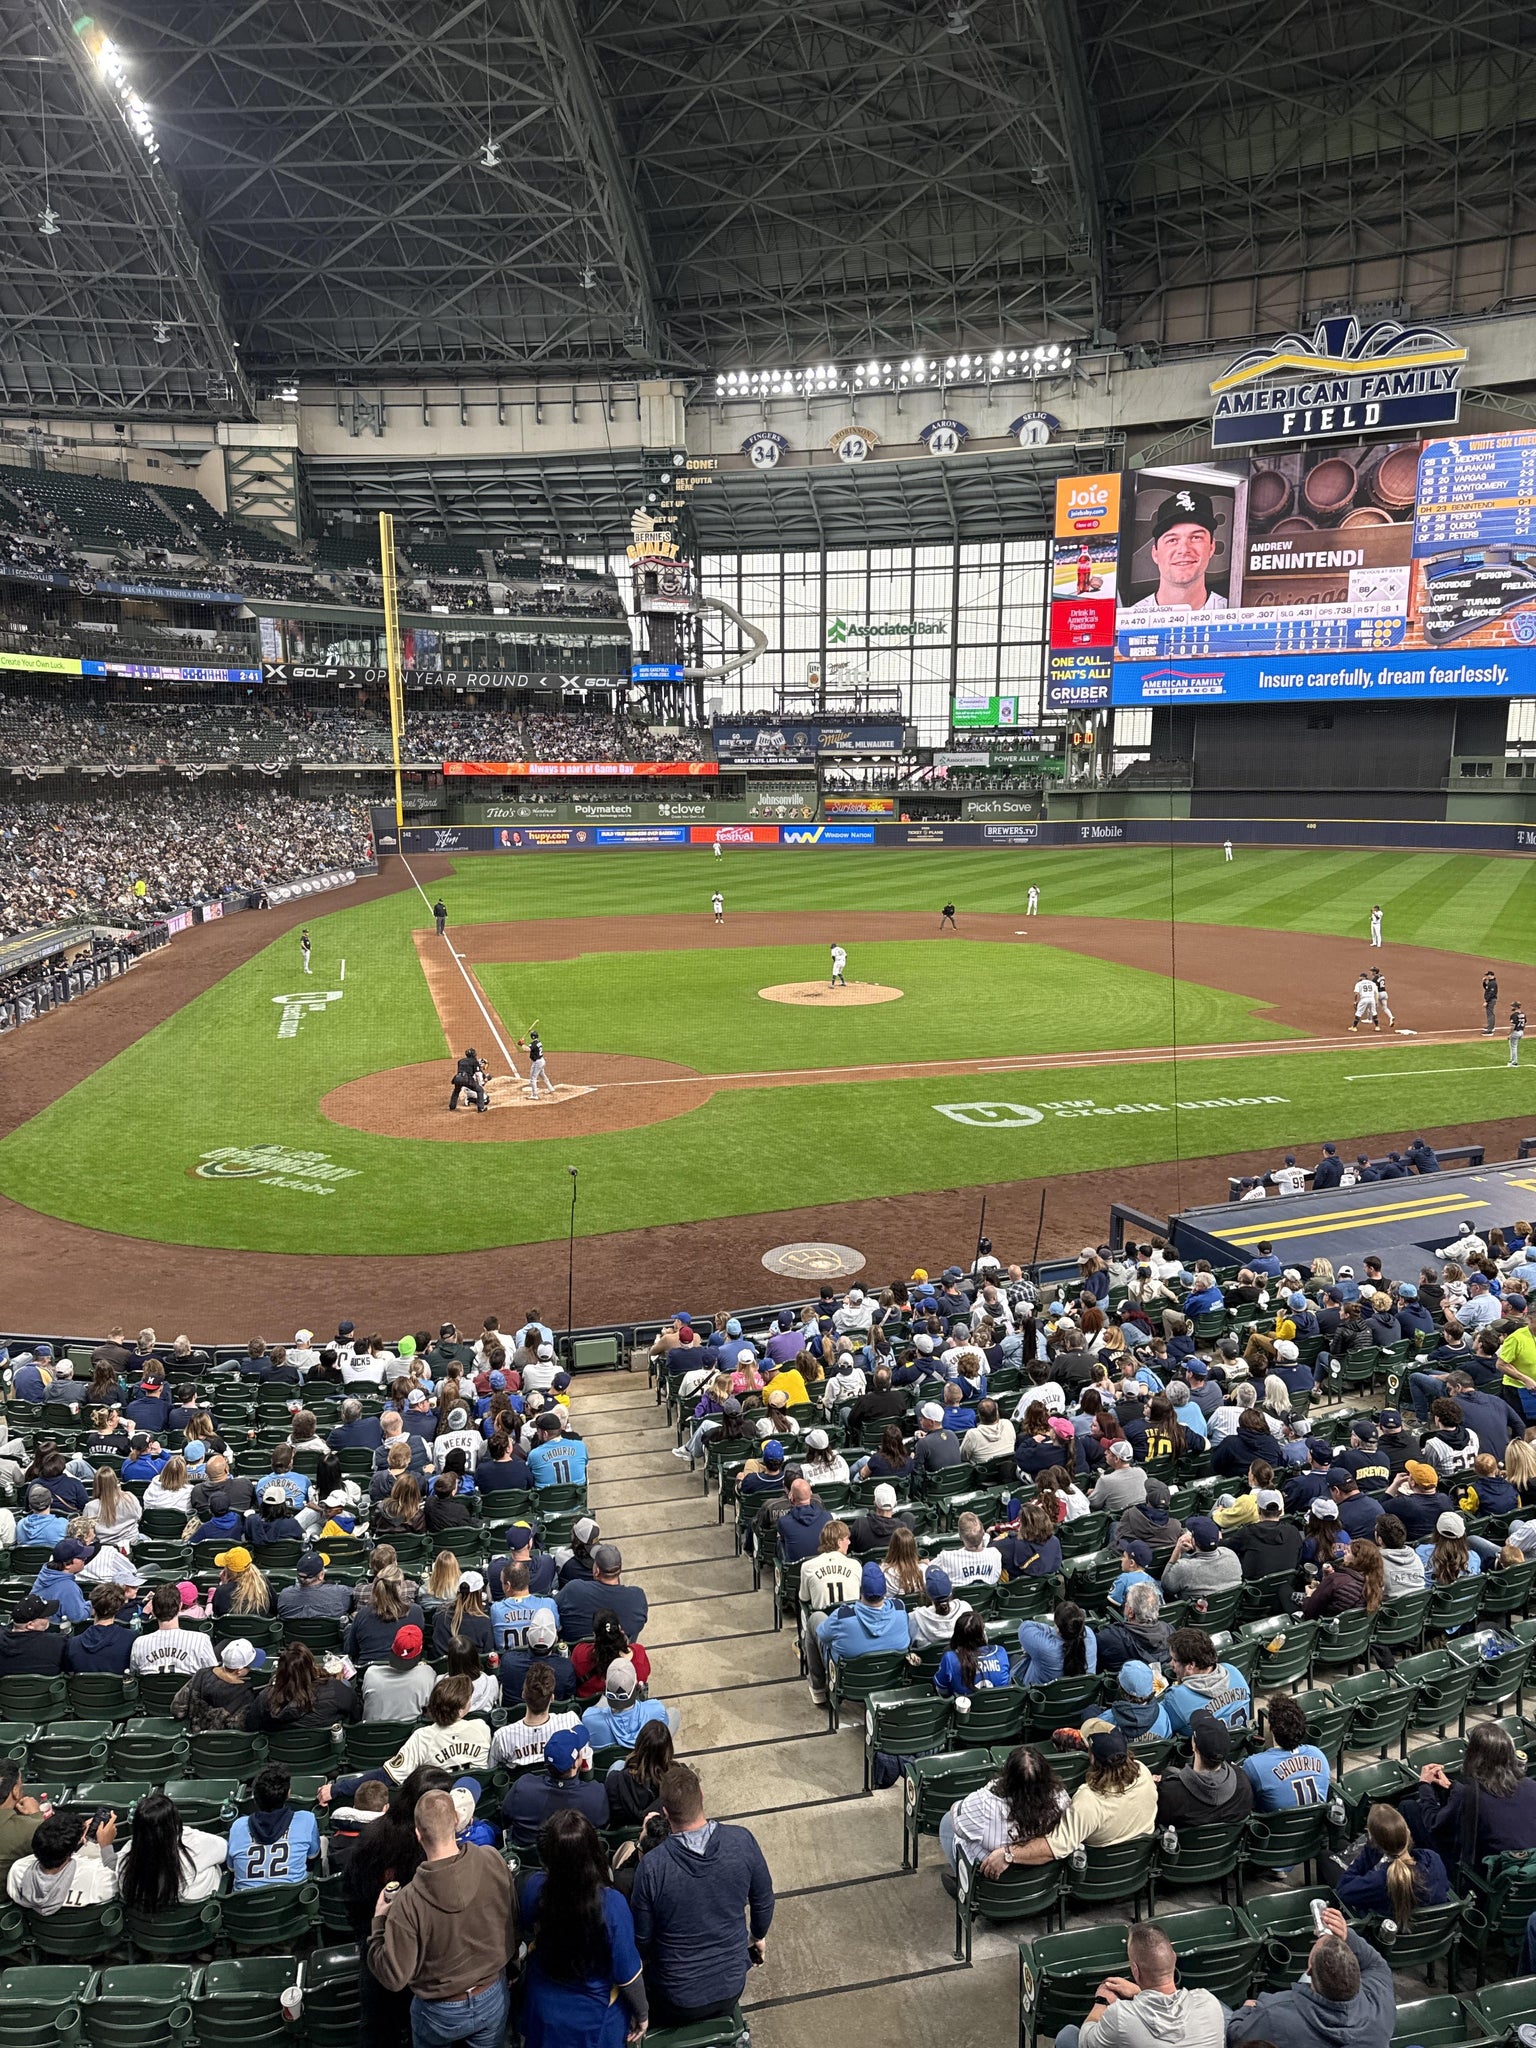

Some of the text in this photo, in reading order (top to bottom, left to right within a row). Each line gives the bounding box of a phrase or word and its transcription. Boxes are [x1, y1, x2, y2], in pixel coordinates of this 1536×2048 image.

[1216, 367, 1460, 416] AMERICAN FAMILY
[1023, 413, 1047, 421] SELIG
[1283, 404, 1380, 434] FIELD
[932, 421, 957, 430] AARON
[749, 432, 781, 443] FINGERS
[834, 426, 870, 441] ROBINSON
[1030, 427, 1039, 445] 1
[933, 434, 954, 451] 44
[1470, 438, 1512, 451] WHITE SOX
[754, 445, 775, 463] 34
[842, 441, 863, 458] 42
[686, 460, 718, 469] GONE!
[1455, 463, 1495, 473] MURAKAMI
[1454, 473, 1486, 482] VARGAS
[1453, 481, 1508, 492] MONTGOMERY
[1068, 484, 1108, 506] Joie
[1452, 493, 1474, 501] HAYS
[1452, 502, 1495, 511] BENINTENDI
[1450, 521, 1476, 530] QUERO
[635, 531, 671, 542] BERNIE'S
[1449, 531, 1479, 539] PETERS
[626, 542, 679, 559] CHALET
[1251, 541, 1293, 552] ANDREW
[1250, 549, 1364, 570] BENINTENDI
[1476, 571, 1511, 580] PERKINS
[1425, 581, 1472, 589] LOCKRIDGE
[166, 590, 191, 598] TEQUILA
[1434, 593, 1459, 601] ORTIZ
[1418, 605, 1453, 613] RENGIFO
[1462, 608, 1502, 617] SÁNCHEZ
[1067, 616, 1098, 624] America's
[1426, 621, 1455, 629] QUERO
[1130, 647, 1156, 656] BREWERS
[1, 657, 65, 669] Create Your Own Luck.
[1052, 656, 1110, 667] ONE CALL...
[240, 672, 259, 681] 2:41
[292, 668, 338, 678] GOLF
[365, 670, 408, 683] OPN
[416, 672, 456, 685] YEAR
[467, 673, 529, 687] ROUND
[584, 678, 628, 687] GOLF
[1051, 669, 1110, 680] THAT'S ALL!
[1258, 663, 1510, 690] Insure carefully, dream fearlessly.
[1143, 678, 1223, 689] AMERICAN FAMILY
[1051, 686, 1108, 700] GRUBER
[818, 732, 852, 747] Miller
[529, 764, 558, 774] Always
[758, 794, 803, 805] Johnsonville
[486, 807, 515, 818] Tito's
[575, 805, 632, 815] Polymatech
[671, 804, 705, 814] clover
[832, 801, 867, 813] Surfside
[968, 802, 991, 812] Pick
[1003, 802, 1032, 812] Save
[715, 830, 753, 842] festival
[988, 826, 1035, 835] BREWERS.TV
[1081, 826, 1122, 838] T Mobile
[529, 832, 570, 841] hupy.com
[1363, 984, 1372, 992] 99
[1035, 1099, 1096, 1109] uw
[1054, 1095, 1292, 1118] credit union
[443, 1438, 471, 1450] WEEKS
[542, 1446, 576, 1463] CHOURIO
[553, 1460, 570, 1484] 11
[815, 1565, 851, 1580] CHOURIO
[962, 1565, 993, 1578] BRAUN
[827, 1582, 844, 1604] 11
[504, 1610, 533, 1624] SULLY
[146, 1647, 188, 1664] CHOURIO
[978, 1660, 1000, 1671] RANG
[435, 1742, 481, 1762] CHOURIO
[1273, 1758, 1321, 1780] CHOURIO
[1292, 1777, 1318, 1806] 11
[248, 1842, 289, 1878] 22
